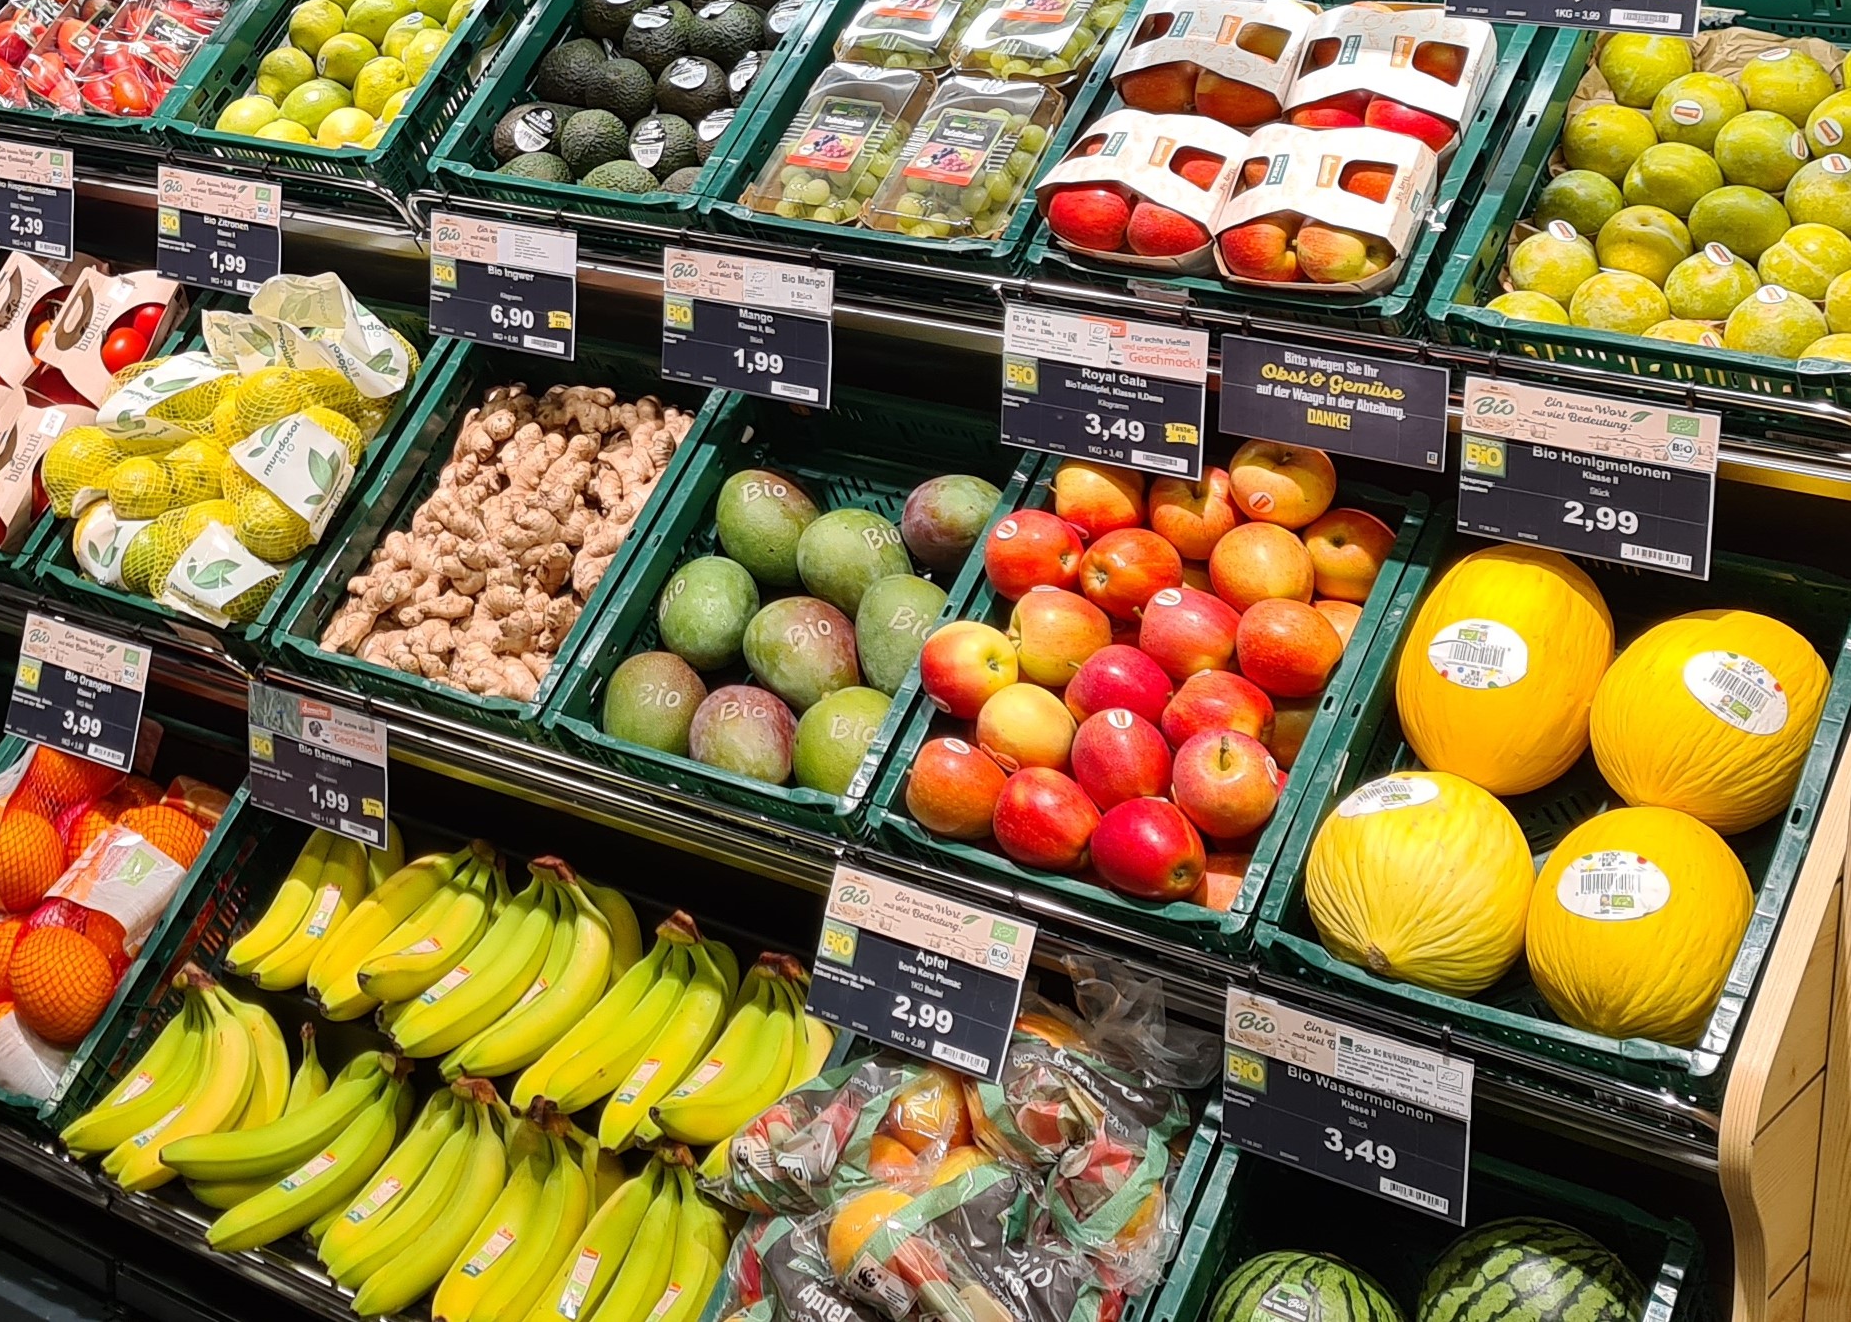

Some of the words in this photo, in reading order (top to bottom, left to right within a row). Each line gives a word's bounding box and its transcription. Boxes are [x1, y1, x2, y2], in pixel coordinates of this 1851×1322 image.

[9, 214, 44, 237] 2,39
[209, 251, 247, 274] 1,99
[487, 265, 502, 277] Bio
[504, 268, 535, 282] Ingwer
[781, 273, 796, 284] Bio
[797, 275, 826, 289] Mango
[73, 301, 113, 353] biofruit
[490, 304, 535, 329] 6,90
[738, 308, 774, 324] Mango
[733, 348, 784, 374] 1,99
[1284, 351, 1308, 368] Bitte
[1309, 356, 1345, 375] wiegen
[1346, 360, 1363, 375] Sie
[1364, 363, 1380, 378] Ihr
[1082, 368, 1116, 384] Royal
[1118, 373, 1148, 389] Gala
[1261, 363, 1308, 386] Obst
[1309, 371, 1327, 387] &
[1329, 375, 1406, 401] Gemüse
[1256, 382, 1273, 397] auf
[1273, 384, 1291, 399] der
[1292, 388, 1325, 406] Waage
[1326, 393, 1336, 406] in
[1337, 395, 1355, 410] der
[1356, 397, 1407, 421] Abteilung.
[1473, 395, 1515, 416] Bio
[1543, 396, 1564, 409] Ein
[1594, 404, 1628, 418] Wort
[1085, 413, 1146, 443] 3,49
[1307, 408, 1351, 431] DANKE!
[1568, 412, 1633, 431] Bedeutung:
[4, 432, 43, 484] biofruit
[263, 420, 302, 478] mundosol
[1532, 445, 1558, 460] Bio
[1560, 448, 1672, 481] Honigmelonen
[1582, 469, 1610, 483] Klasse
[741, 480, 788, 503] Bio
[1562, 500, 1640, 535] 2,99
[861, 526, 901, 552] Bio
[784, 618, 833, 651] Bio
[64, 670, 78, 684] Bio
[79, 675, 113, 694] Orangen
[62, 709, 102, 738] 3,99
[719, 701, 768, 721] Bio
[298, 743, 313, 756] Bio
[314, 747, 353, 768] Bananen
[308, 784, 350, 813] 1,99
[838, 885, 871, 906] Bio
[915, 948, 949, 971] Äpfel
[891, 995, 954, 1035] 2,99
[1287, 1065, 1312, 1083] Bio
[1314, 1073, 1435, 1124] Wassermelonen
[1340, 1098, 1369, 1116] Klasse
[1323, 1126, 1397, 1170] 3,49
